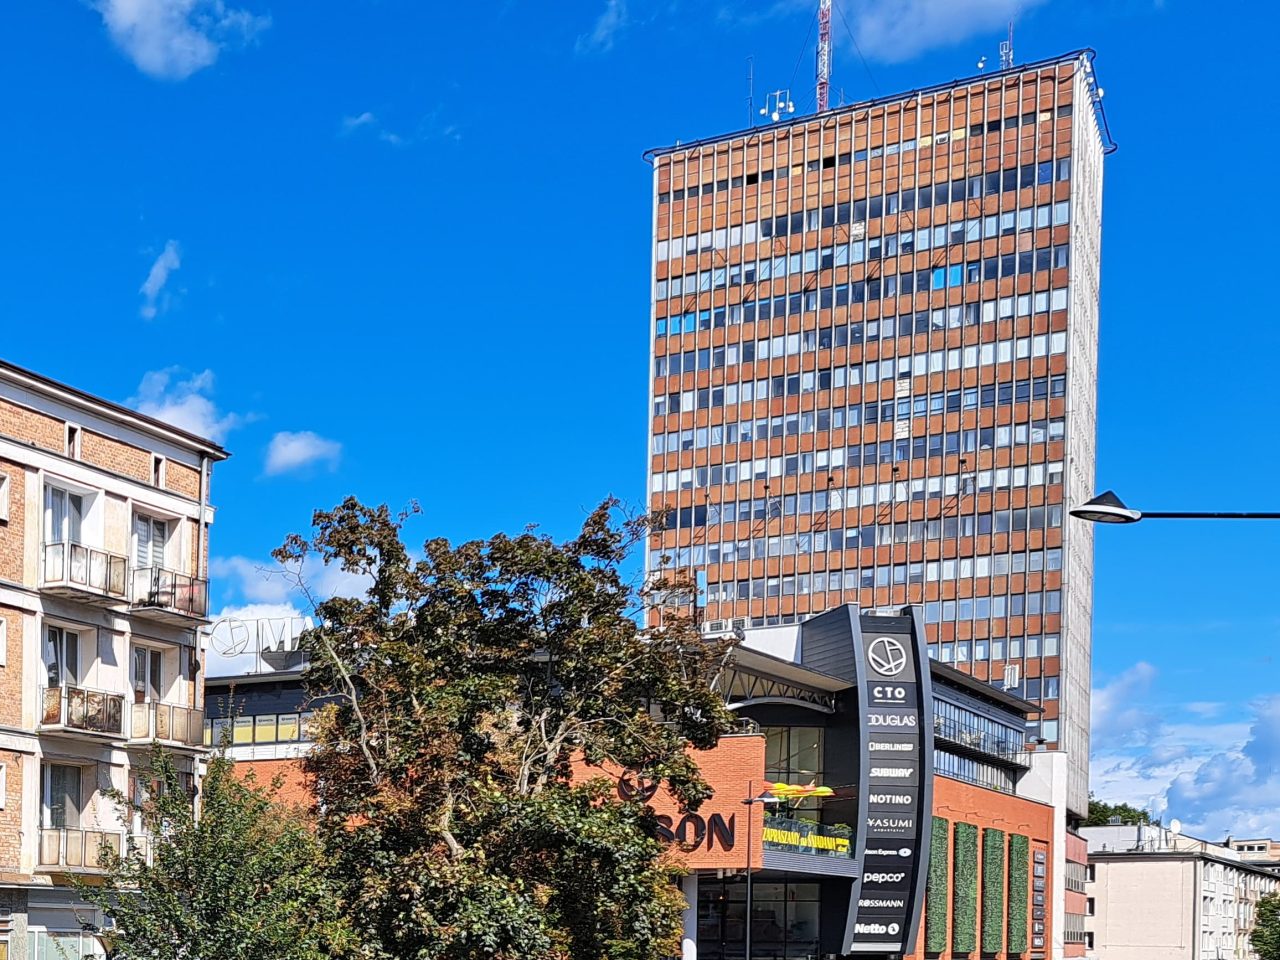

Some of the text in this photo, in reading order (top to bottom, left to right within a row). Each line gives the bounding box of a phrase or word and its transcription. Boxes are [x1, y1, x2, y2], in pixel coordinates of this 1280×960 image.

[873, 687, 906, 698] CTO
[867, 714, 916, 727] DOUGLAS
[869, 768, 914, 778] SUBWAY
[869, 794, 912, 805] NOTINO
[867, 818, 913, 828] YASUMI
[863, 872, 902, 884] pepco
[858, 899, 904, 908] ROSSMANN
[854, 923, 887, 934] Netto
